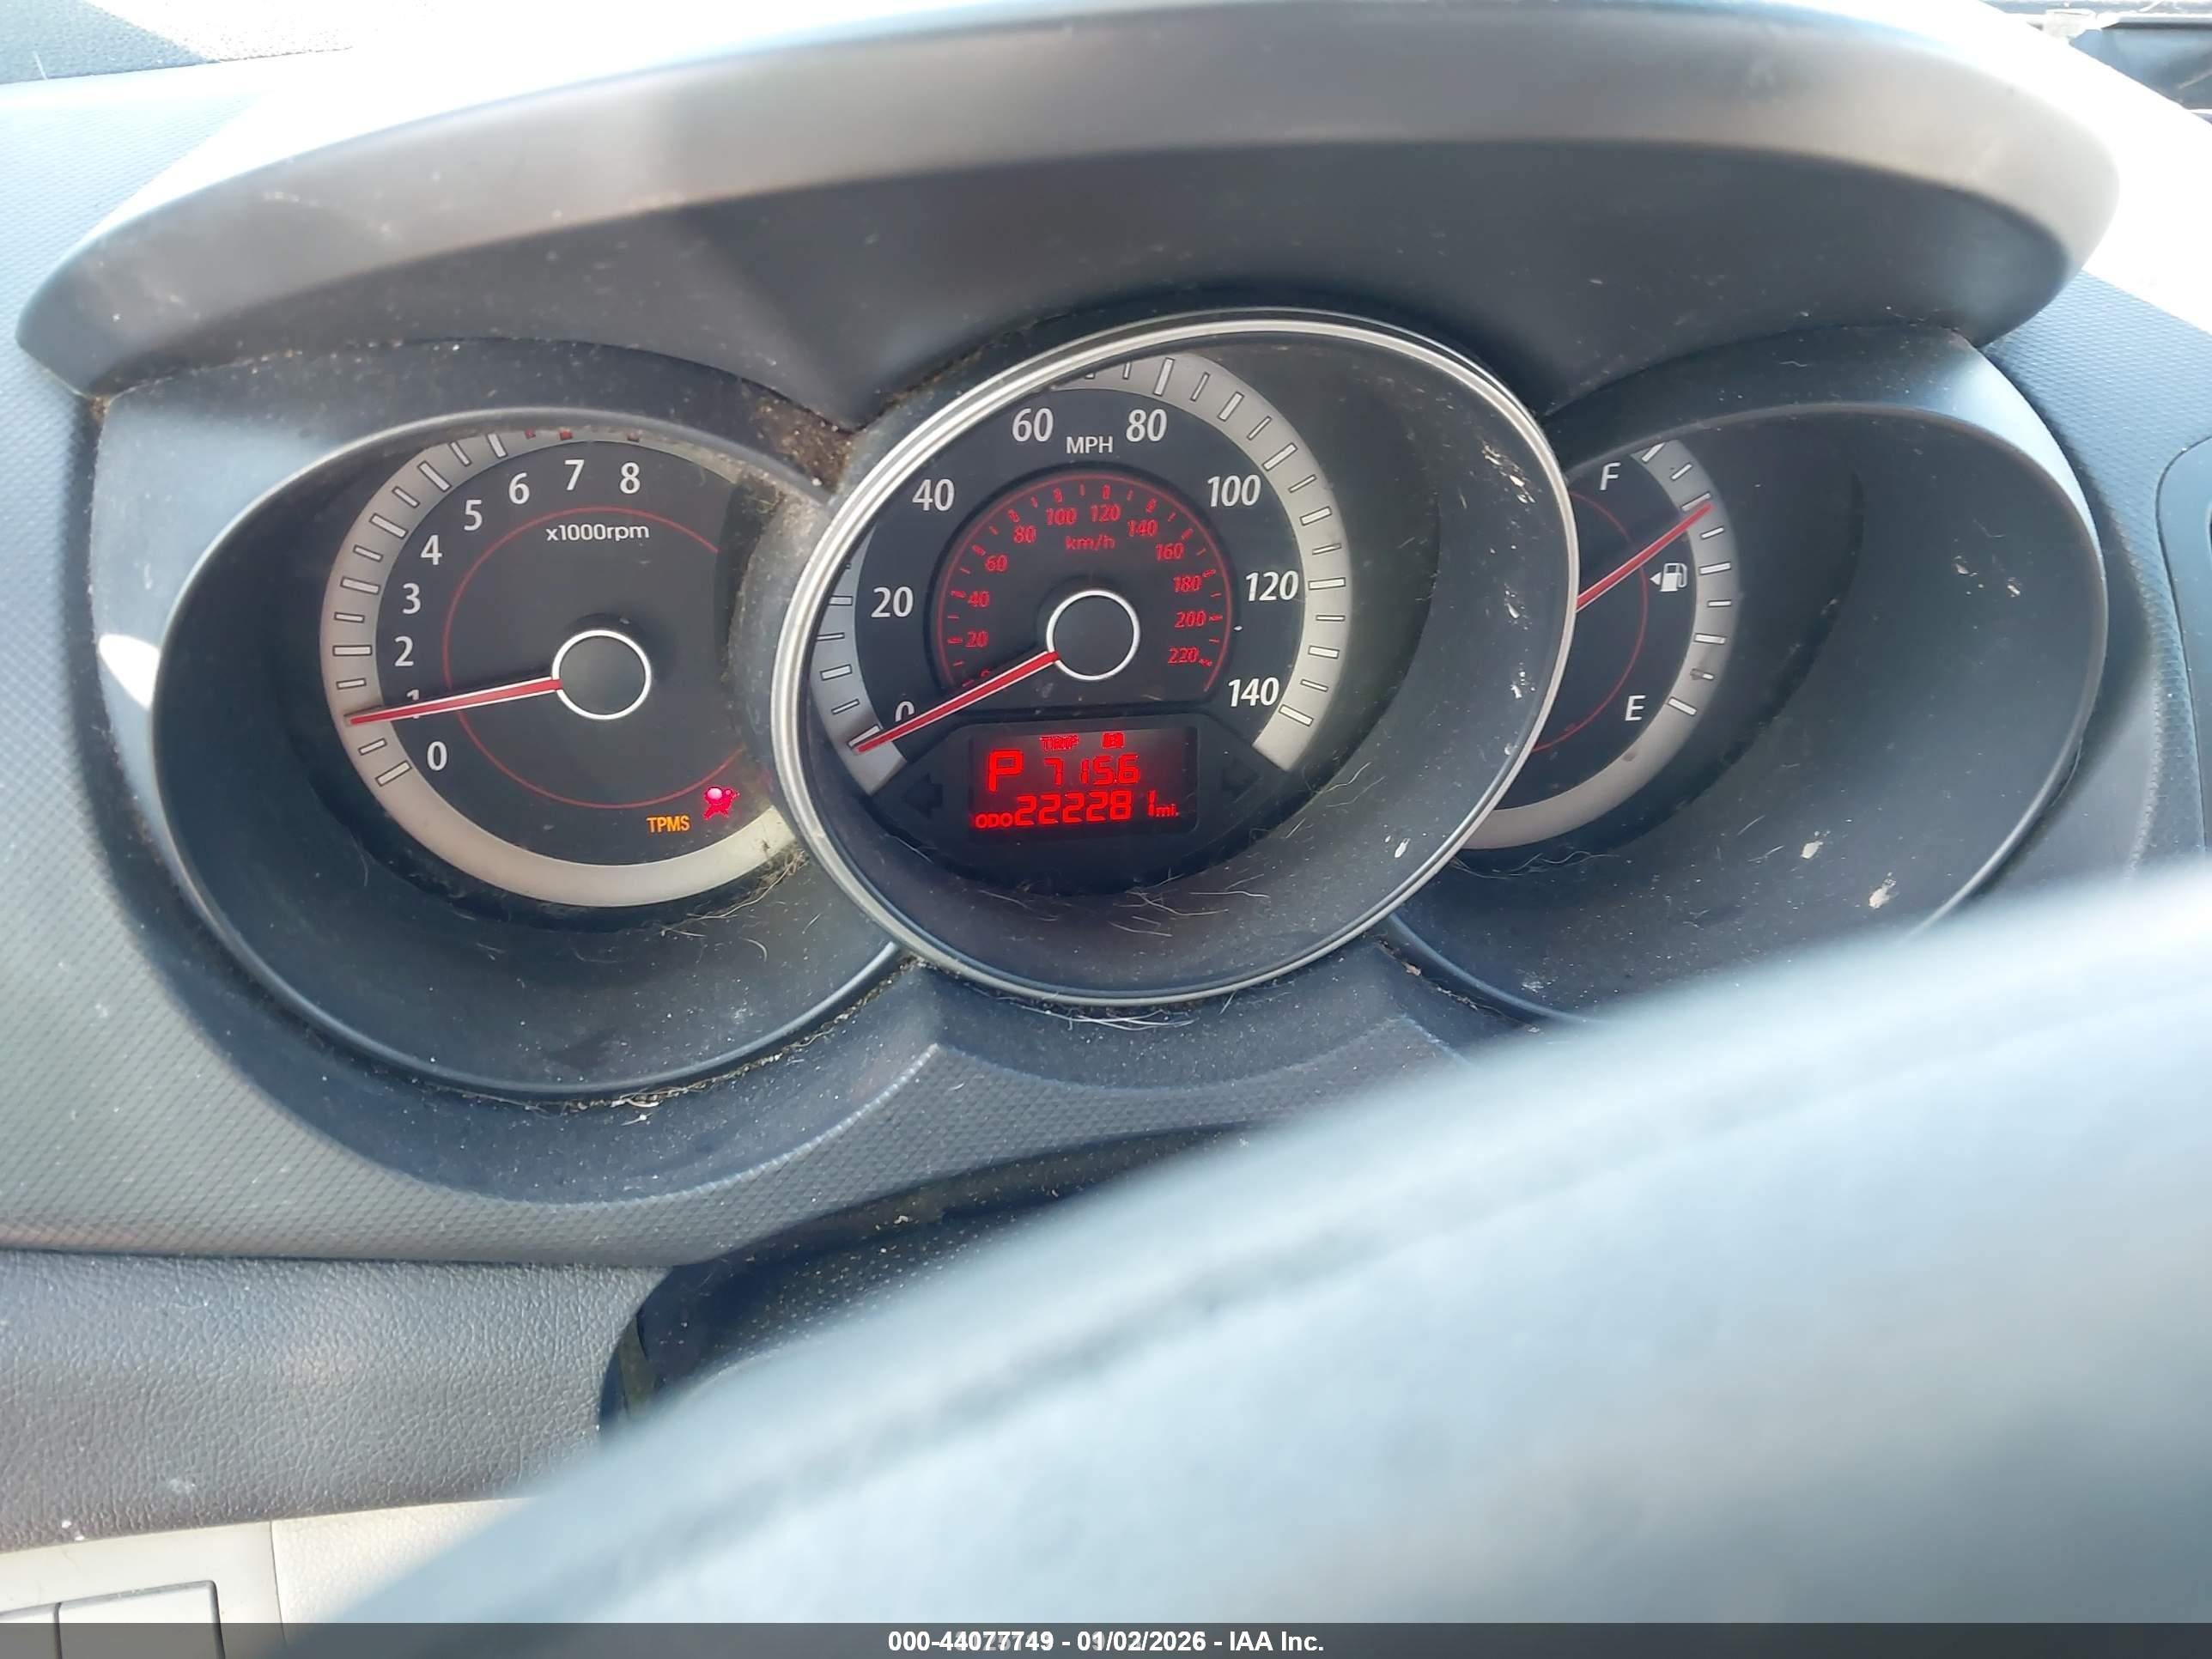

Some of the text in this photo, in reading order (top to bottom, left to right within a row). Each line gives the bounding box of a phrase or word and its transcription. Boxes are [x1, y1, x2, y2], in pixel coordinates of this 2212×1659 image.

[1012, 408, 1054, 442] 60
[1126, 408, 1167, 442] 80
[1066, 435, 1114, 454] MPH
[507, 472, 531, 505] 6
[563, 459, 586, 491] 7
[619, 462, 641, 495] 8
[1599, 461, 1621, 491] F
[912, 478, 956, 512] 40
[1207, 474, 1262, 507] 100
[463, 499, 483, 532] 5
[1046, 507, 1078, 526] 100
[1090, 504, 1121, 523] 120
[545, 521, 650, 542] x1000rpm
[1013, 525, 1037, 544] 80
[1065, 534, 1116, 552] km/h
[1127, 520, 1159, 538] 140
[421, 534, 442, 566] 4
[984, 555, 1009, 573] 60
[1155, 543, 1186, 561] 160
[1173, 574, 1202, 592] 180
[1245, 570, 1299, 602] 120
[402, 583, 422, 615] 3
[870, 585, 914, 617] 20
[967, 590, 990, 608] 40
[1174, 611, 1207, 629] 200
[393, 635, 415, 667] 2
[965, 629, 989, 648] 20
[1167, 647, 1200, 665] 220
[1228, 677, 1280, 708] 140
[1625, 694, 1647, 722] E
[427, 741, 447, 771] 0
[988, 750, 1024, 793] P
[647, 815, 690, 834] TPMS
[975, 812, 1013, 830] ODO
[1013, 789, 1156, 827] 222281
